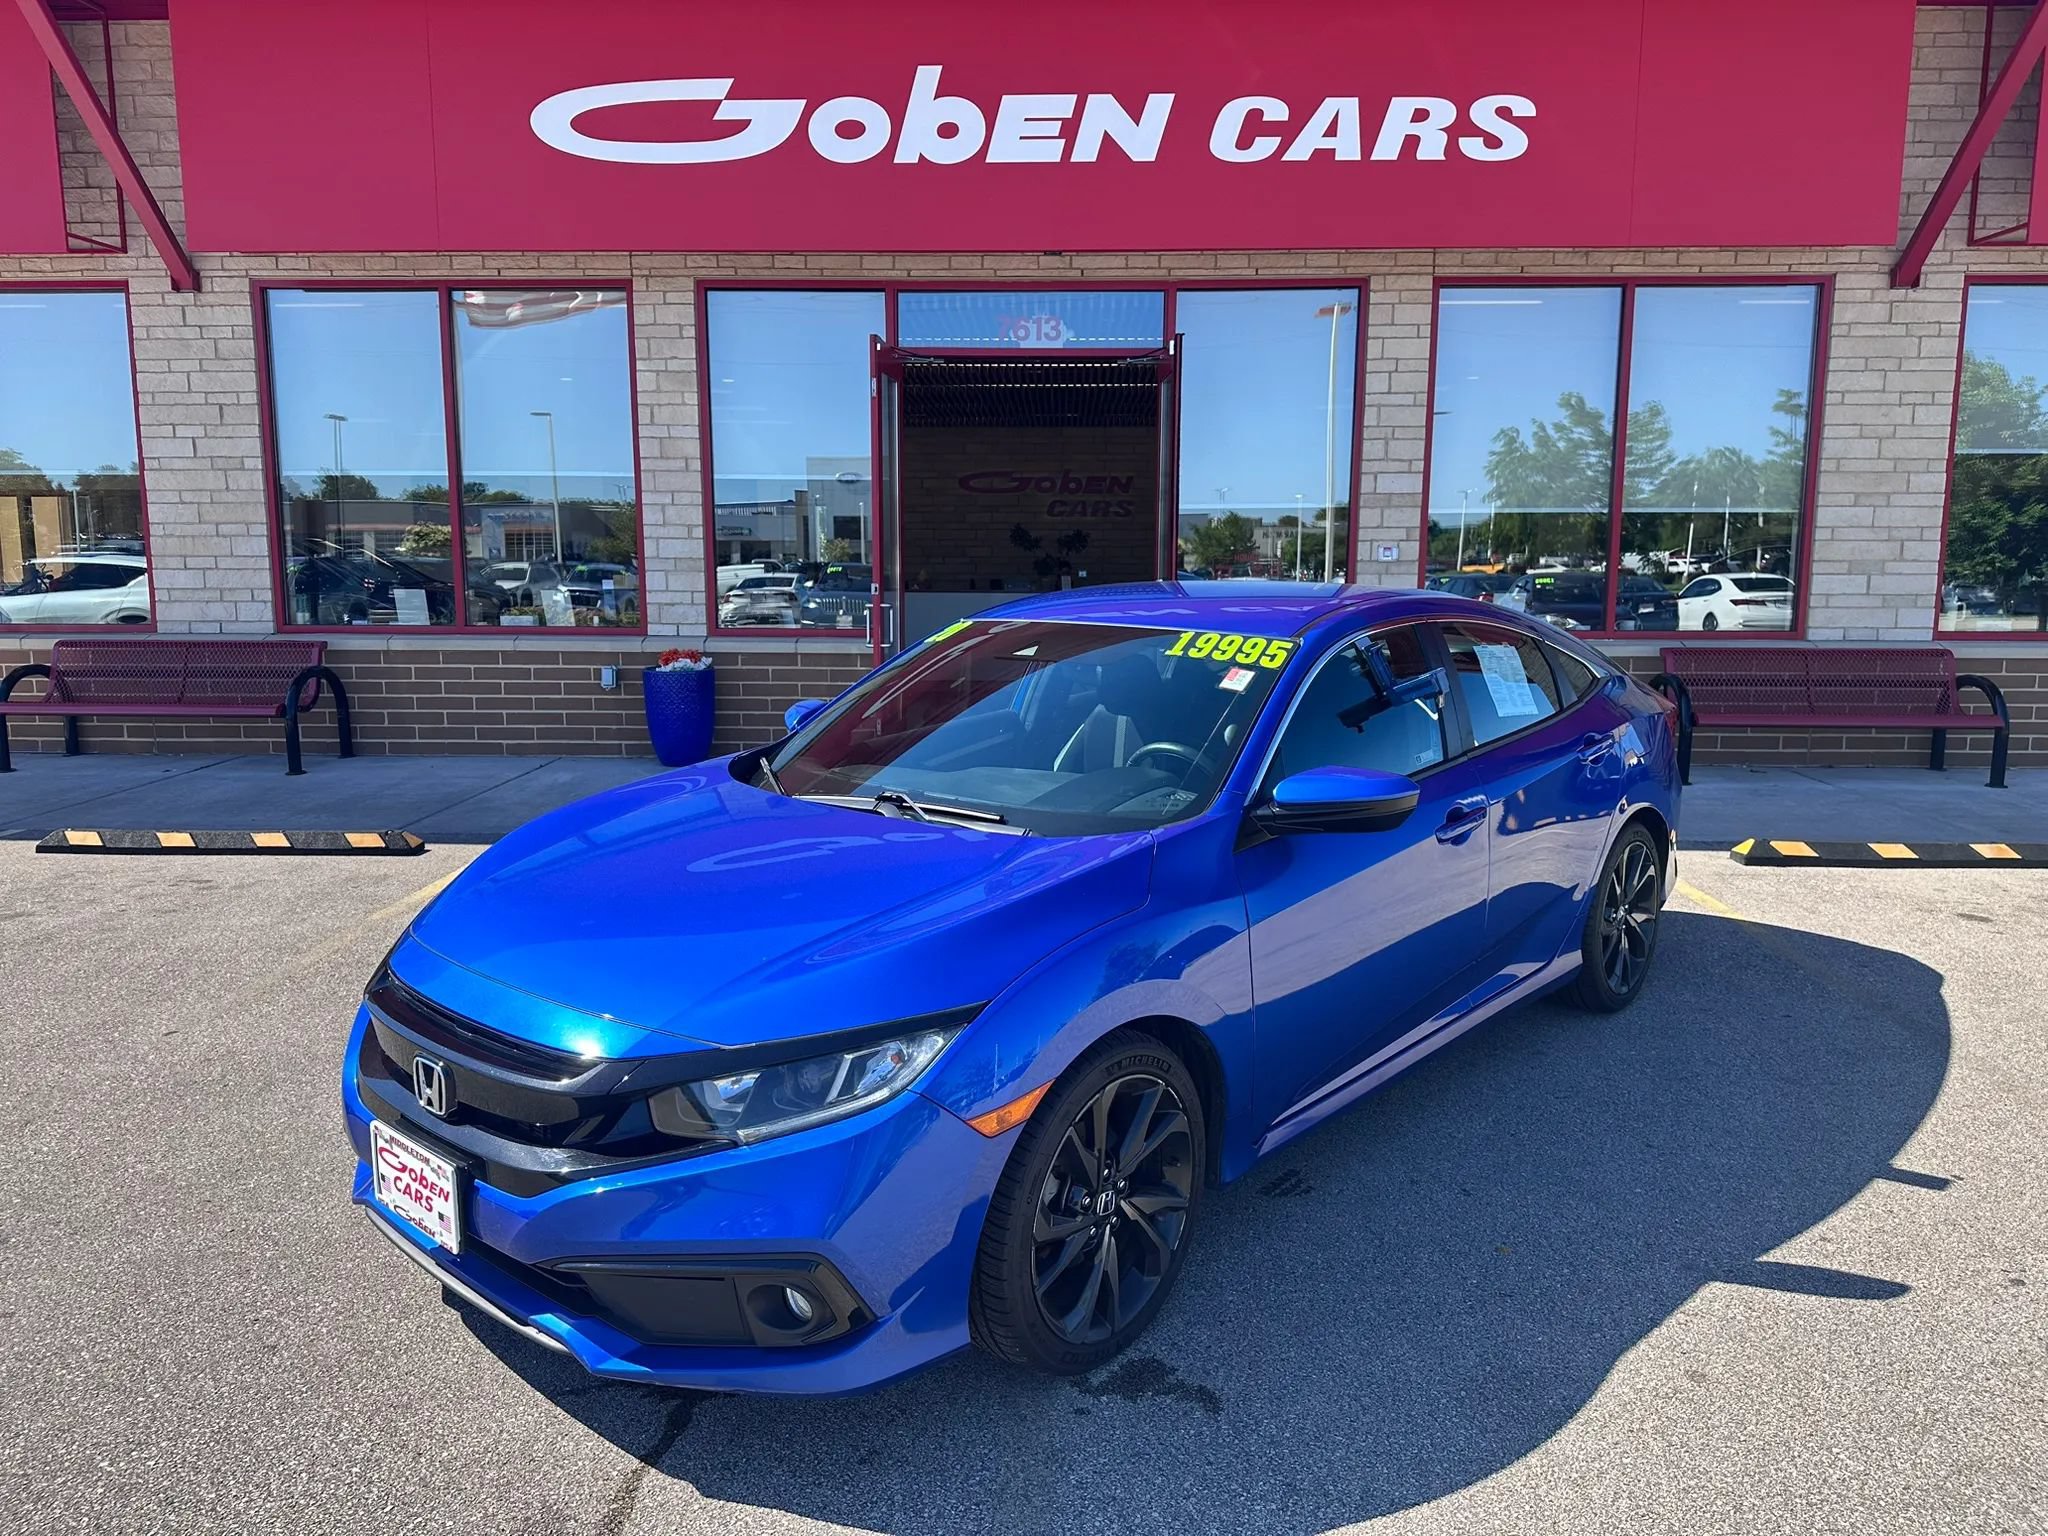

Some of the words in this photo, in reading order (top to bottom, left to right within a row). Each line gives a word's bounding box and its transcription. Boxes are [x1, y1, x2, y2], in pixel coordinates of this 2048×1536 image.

[1208, 95, 1537, 163] CARS
[996, 316, 1063, 343] 7613
[1046, 500, 1135, 518] CARS
[1165, 632, 1293, 669] 19995
[1121, 1056, 1169, 1072] MICHELIN
[390, 1135, 430, 1165] MIDDLETON
[393, 1176, 434, 1213] CARS
